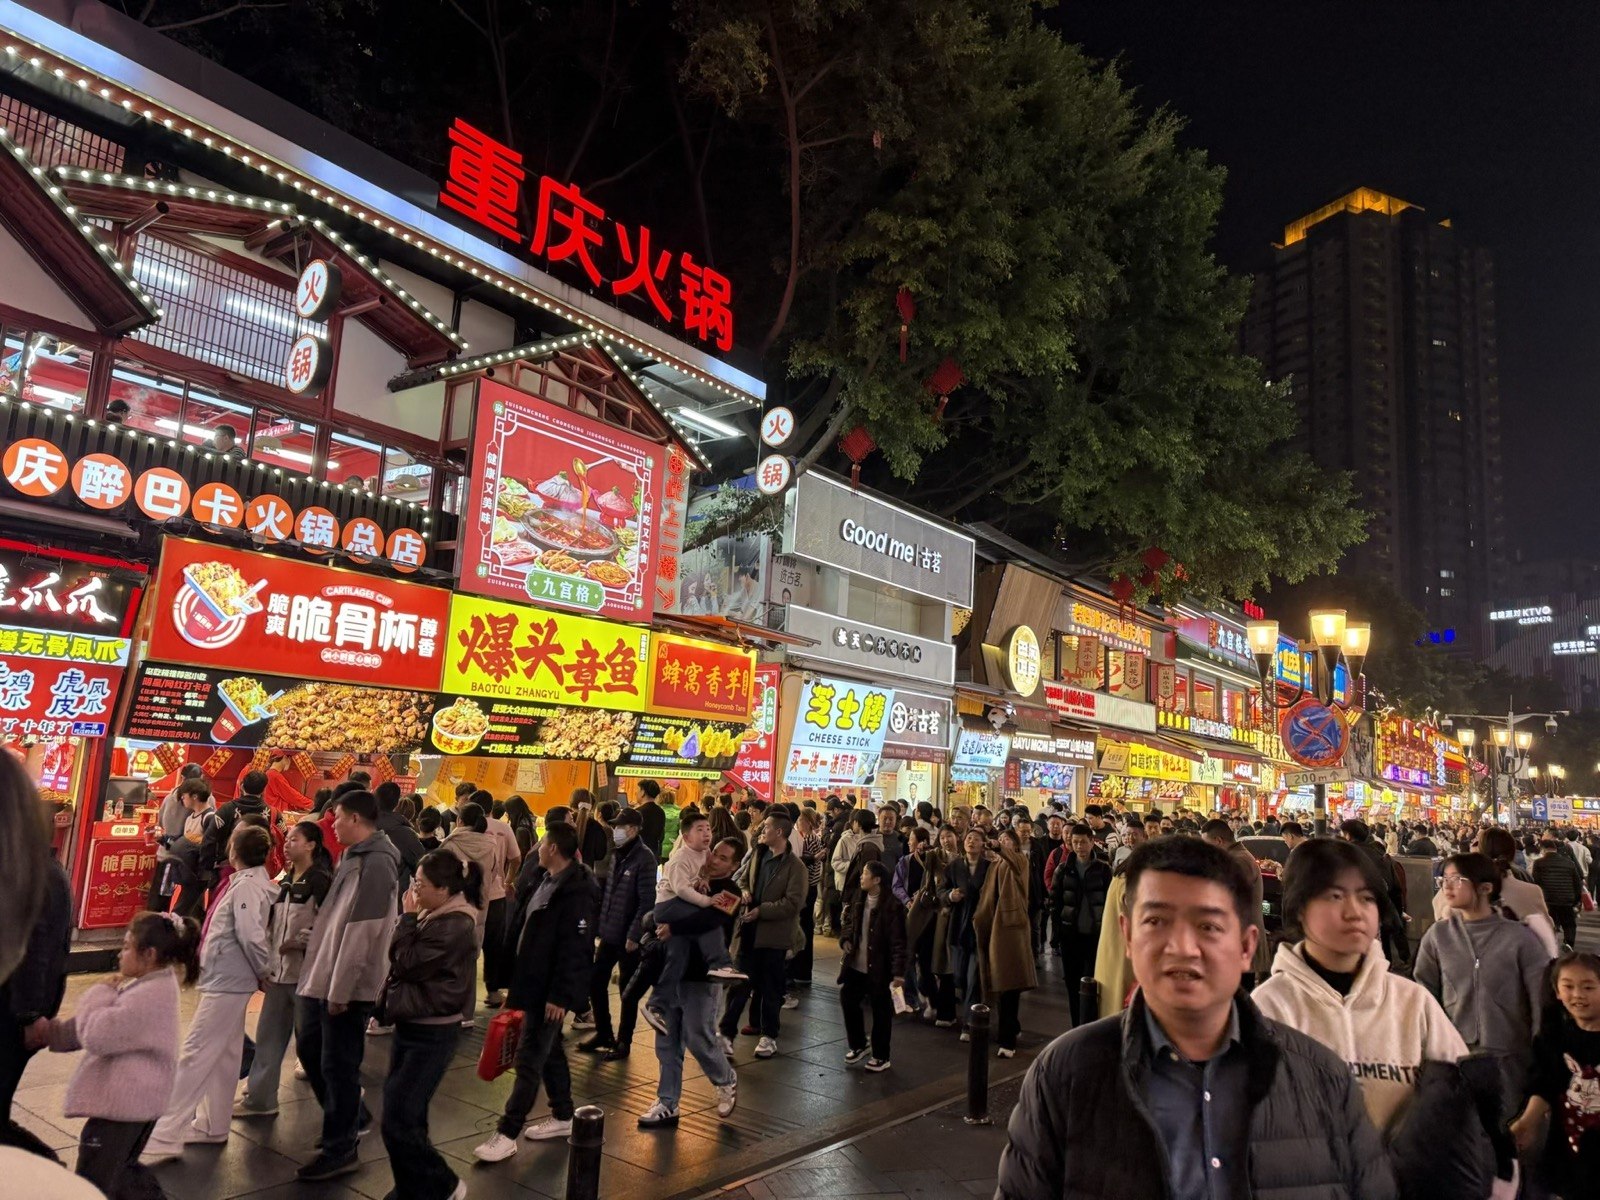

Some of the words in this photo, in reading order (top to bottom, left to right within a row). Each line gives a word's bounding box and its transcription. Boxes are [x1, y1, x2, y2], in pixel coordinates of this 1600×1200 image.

[440, 117, 732, 351] 重庆火锅
[292, 271, 321, 383] 火锅
[552, 418, 585, 433] CHONGQING
[763, 415, 786, 487] 火锅
[481, 452, 498, 525] 健康又美味
[640, 501, 652, 569] 好吃又不贵
[842, 519, 888, 552] Good
[891, 538, 914, 562] me
[921, 547, 942, 573] 古茗
[325, 586, 374, 599] CARTILAGES
[376, 593, 393, 605] CUP
[541, 577, 590, 603] 九宫格
[265, 593, 288, 635] 脆爽
[287, 595, 418, 655] 脆骨杯
[1522, 607, 1543, 617] KTV
[418, 618, 438, 657] 醇香
[457, 612, 639, 702] 爆头章鱼
[471, 682, 511, 696] BAOTOU
[516, 687, 560, 700] ZHANGYU
[660, 658, 742, 700] 蜂窝香芋
[49, 671, 85, 716] 虎皮
[82, 680, 108, 712] 凤爪
[704, 700, 734, 712] Honeycomb
[766, 695, 775, 725] 九宫格
[805, 684, 887, 734] 芝士棒
[918, 708, 941, 735] 古茗
[3, 717, 72, 734] 了十年了
[481, 743, 513, 755] 一口爆头
[809, 733, 842, 745] CHEESE
[846, 735, 870, 747] STICK
[1012, 738, 1031, 750] BAYU
[789, 750, 828, 774] 买一送一
[742, 771, 769, 783] 老火锅
[1294, 773, 1327, 785] 200m
[1535, 805, 1545, 817] P
[101, 854, 155, 873] 脆骨杯
